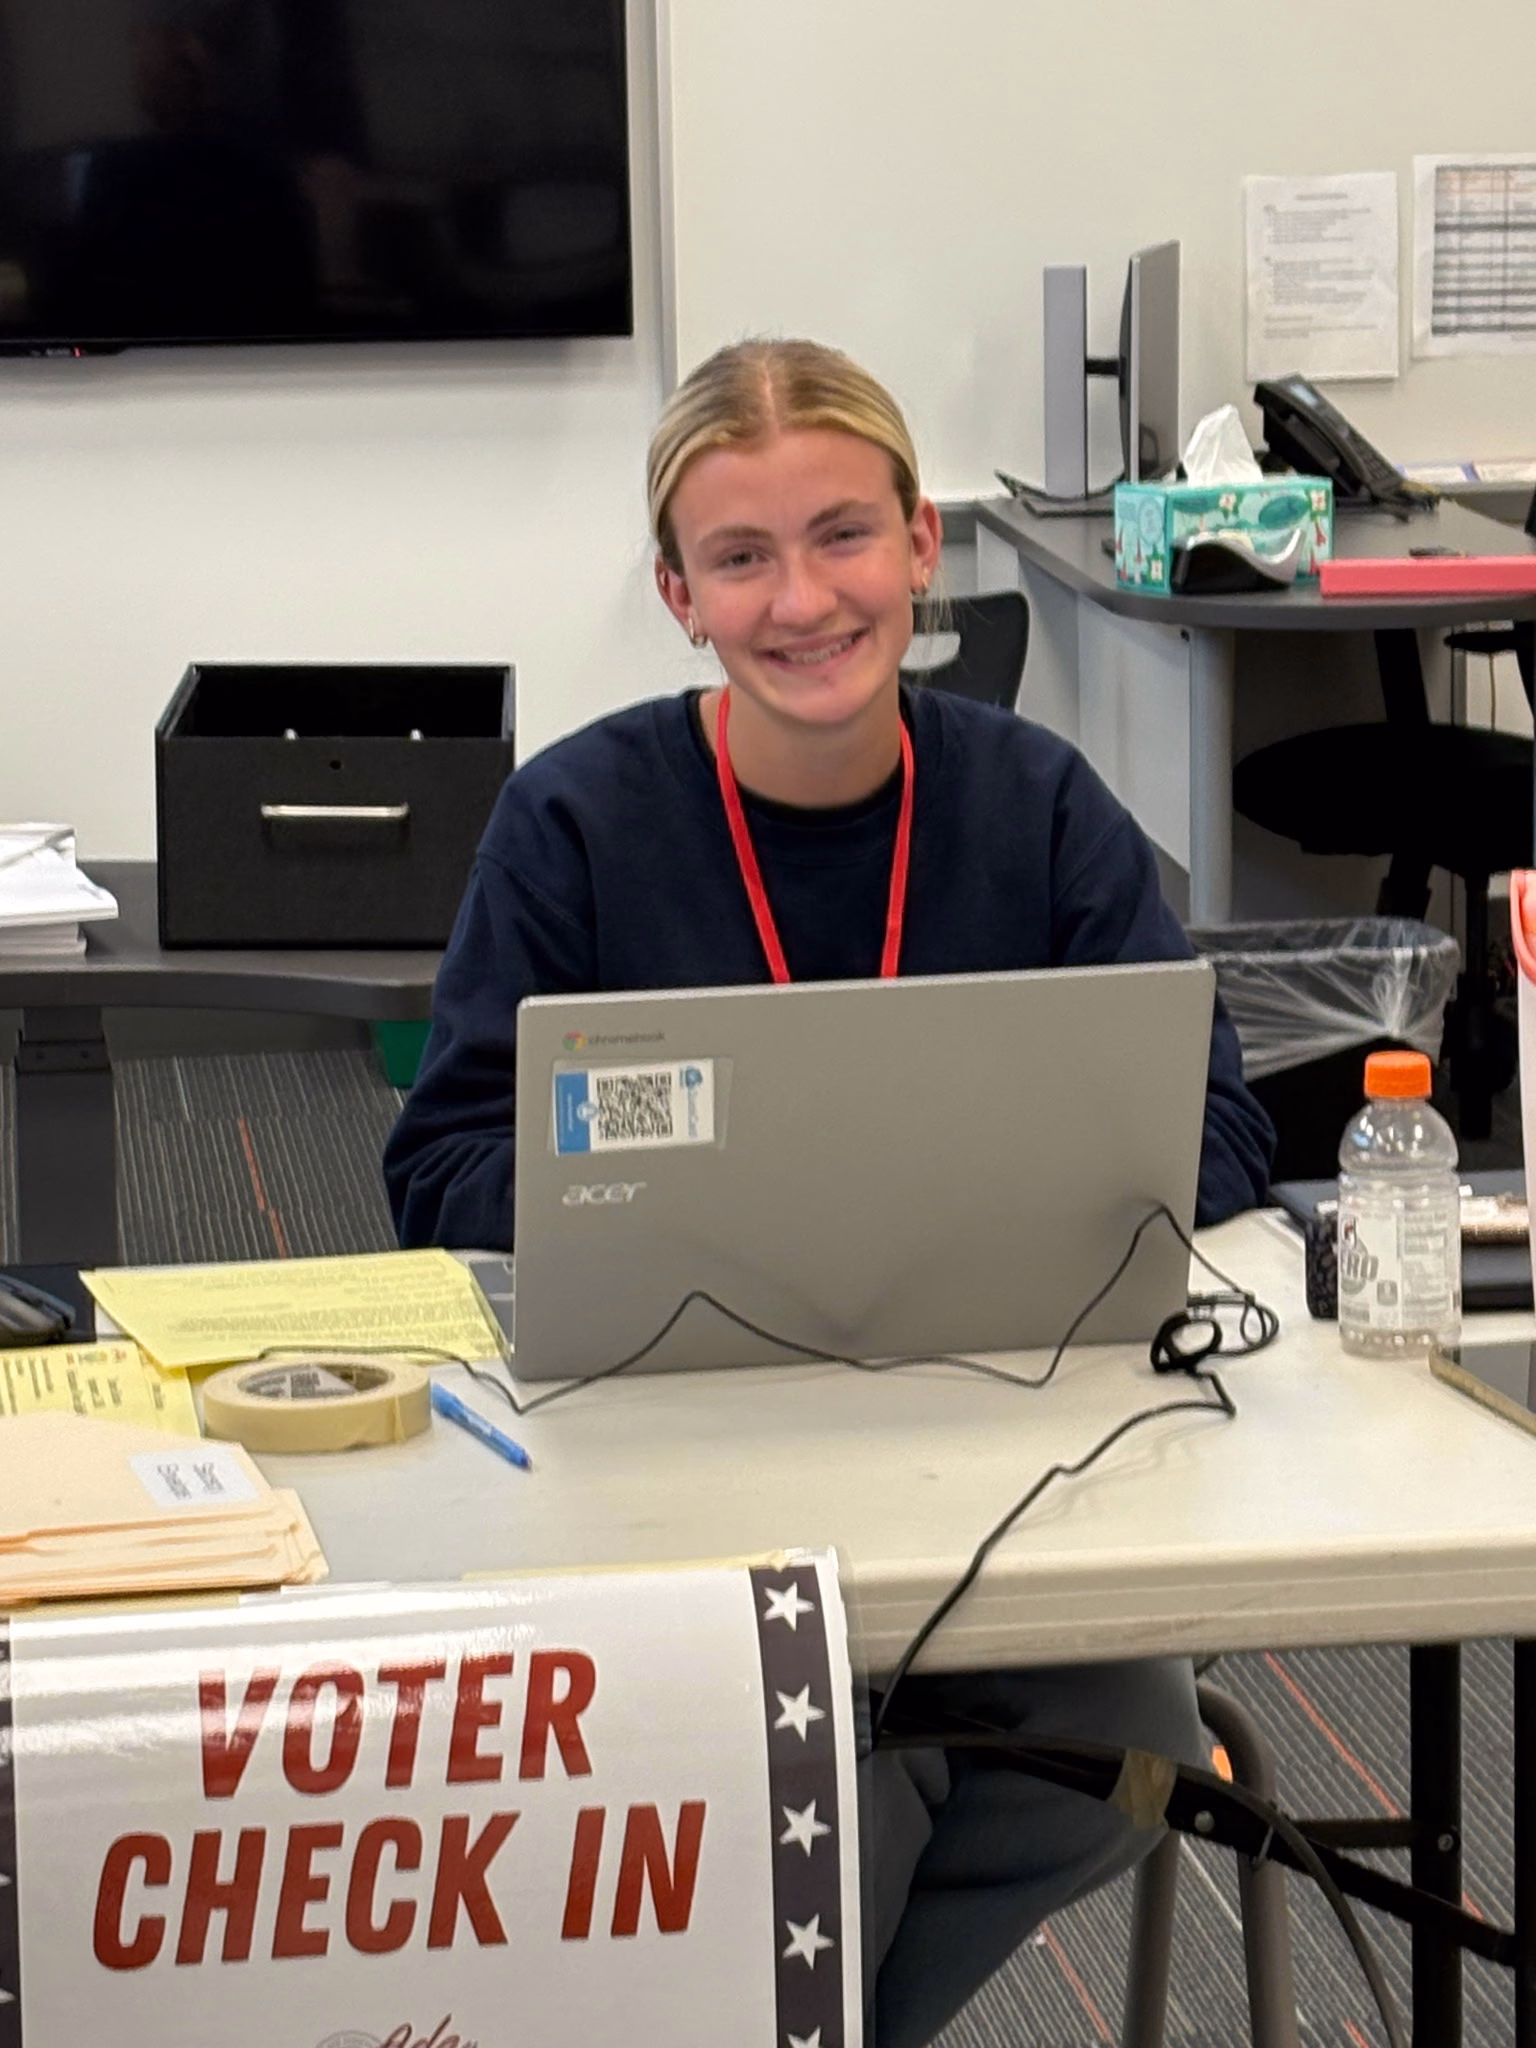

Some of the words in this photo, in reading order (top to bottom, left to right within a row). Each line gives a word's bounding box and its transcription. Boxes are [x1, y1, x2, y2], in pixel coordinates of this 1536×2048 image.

[562, 1181, 647, 1206] acer
[198, 1648, 597, 1800] VOTER
[93, 1810, 520, 1971] CHECK
[561, 1800, 706, 1943] IN
